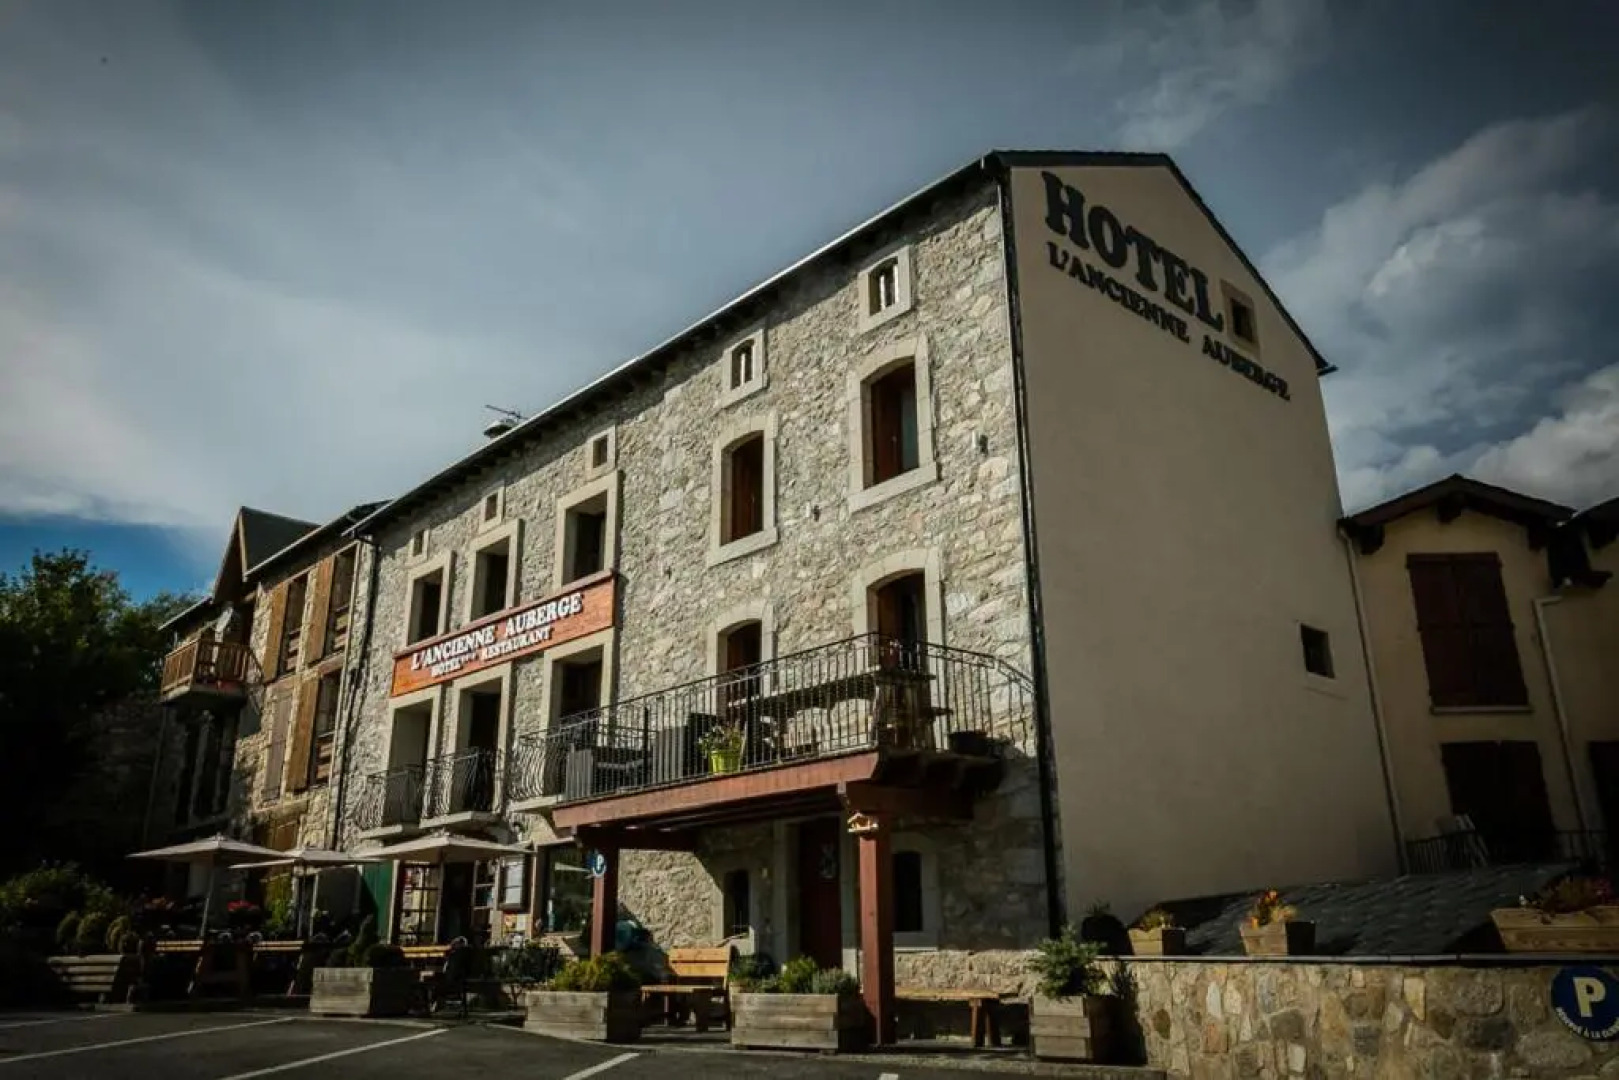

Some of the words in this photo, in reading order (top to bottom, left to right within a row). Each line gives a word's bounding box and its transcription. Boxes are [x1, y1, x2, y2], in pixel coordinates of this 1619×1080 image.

[1041, 170, 1223, 332] HOTEL
[1047, 241, 1190, 344] L'ANCIENNE
[411, 625, 496, 671] L'ANCIENNE
[505, 592, 583, 637] AUBERGE
[481, 627, 552, 661] RESTAURANT
[1572, 976, 1606, 1018] P
